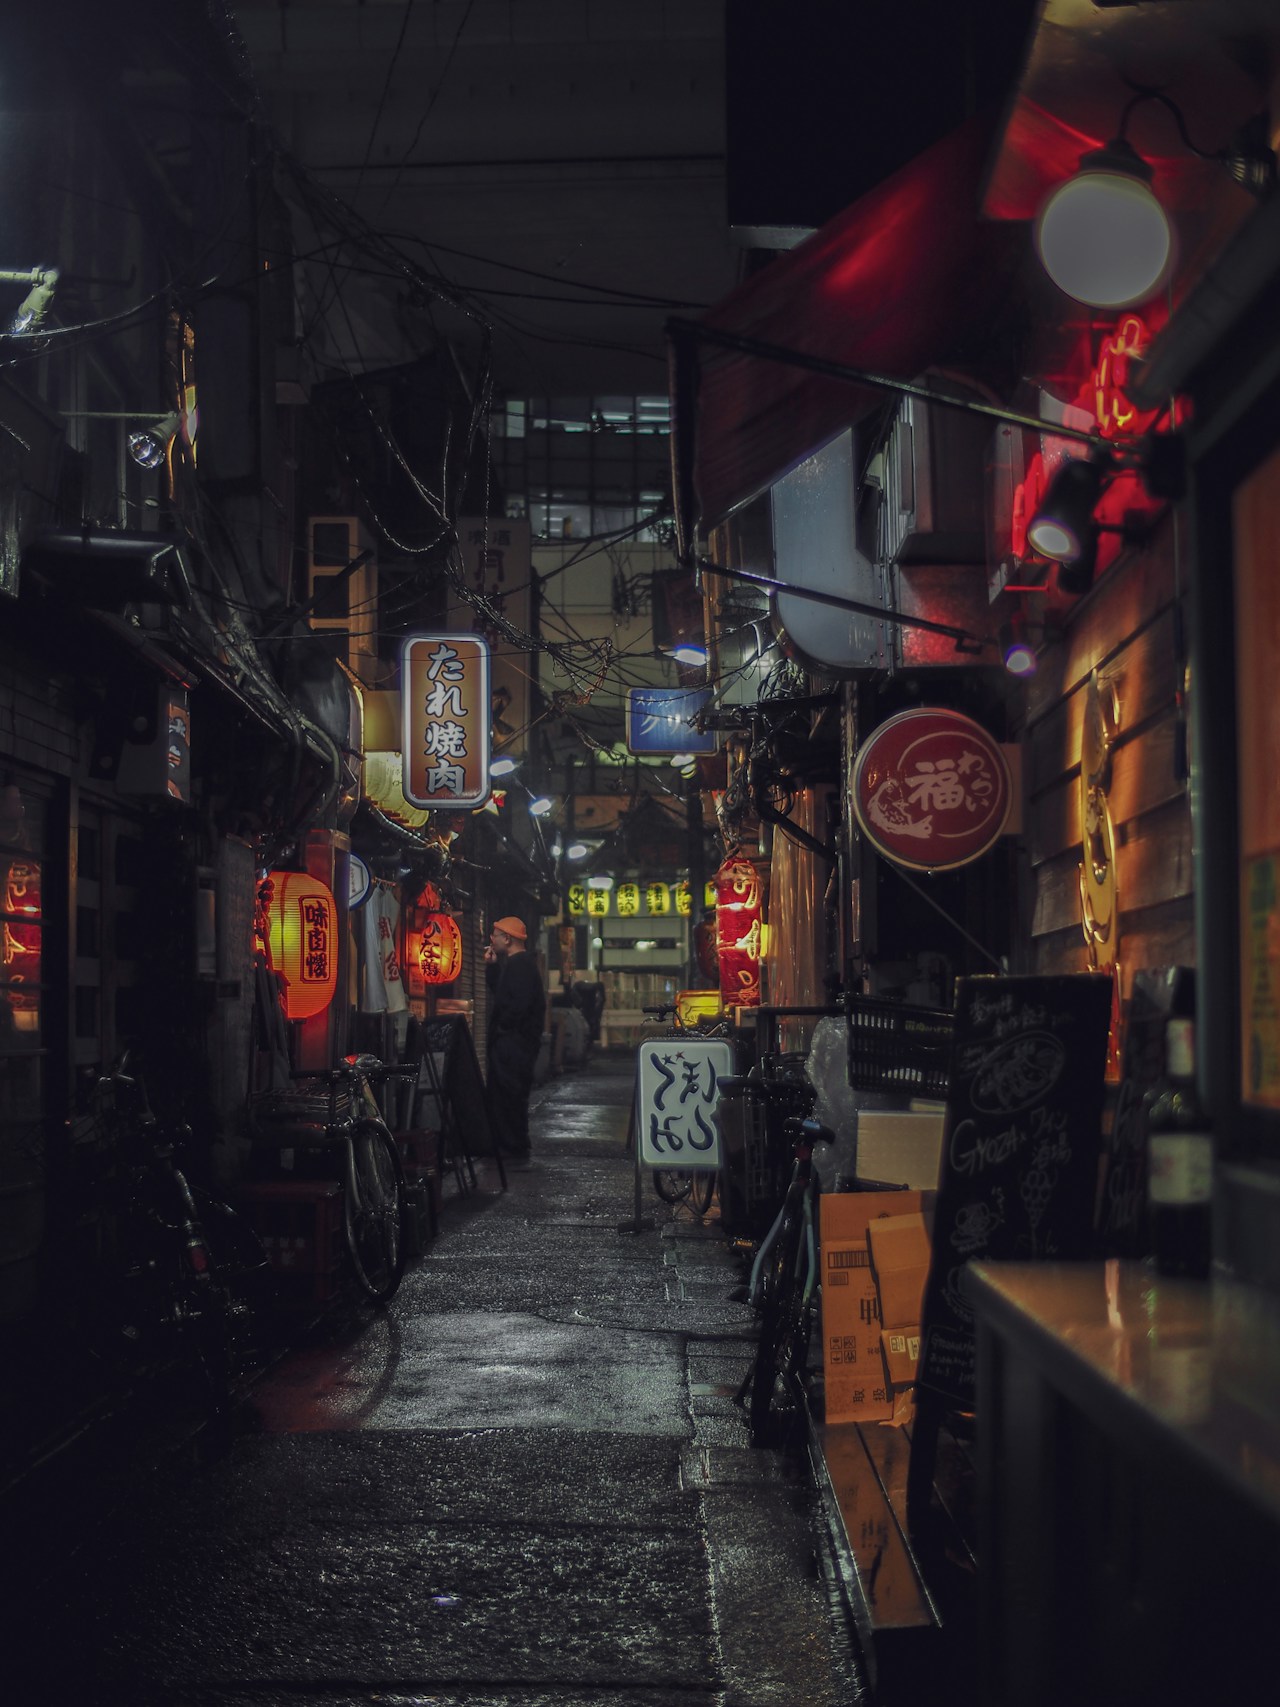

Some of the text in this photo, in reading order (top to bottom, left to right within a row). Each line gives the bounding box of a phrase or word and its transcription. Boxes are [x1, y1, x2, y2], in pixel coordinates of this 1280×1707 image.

[424, 642, 468, 795] たれ焼肉
[904, 750, 993, 812] 福 わらい
[950, 1118, 1017, 1177] GYOZA
